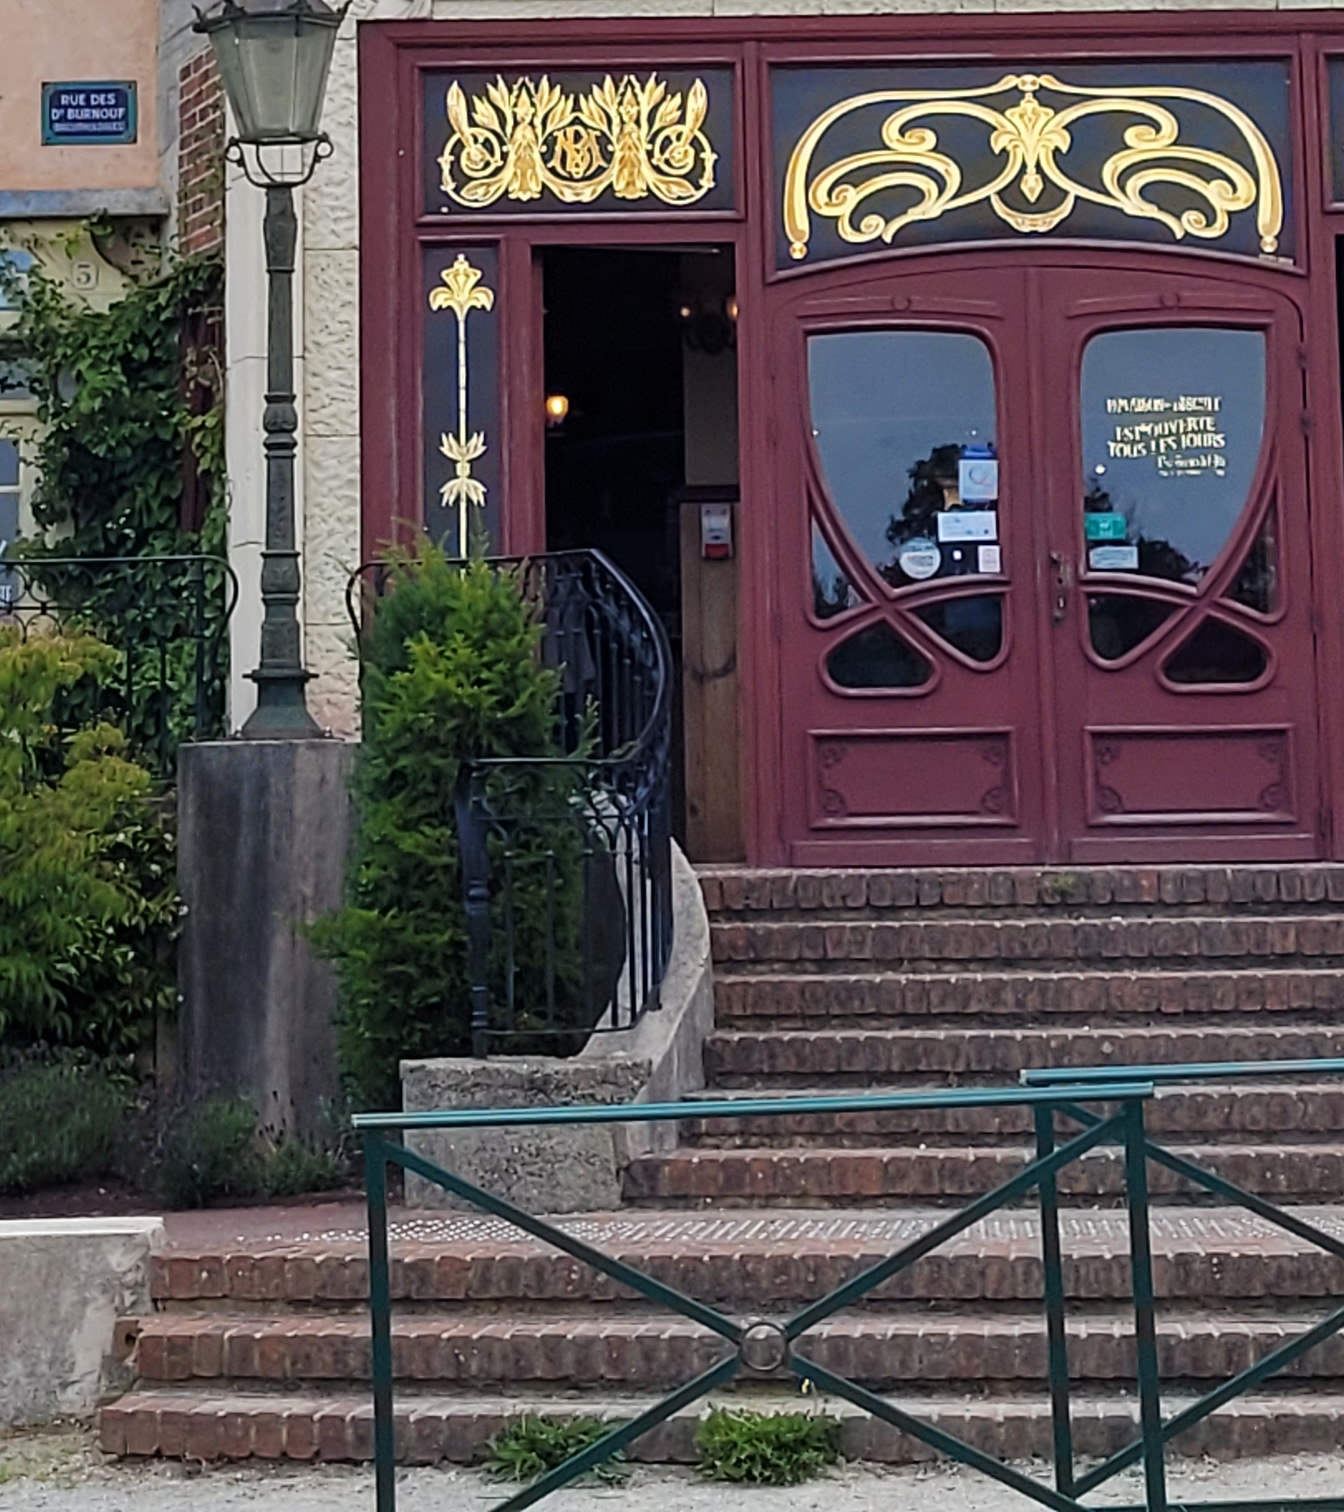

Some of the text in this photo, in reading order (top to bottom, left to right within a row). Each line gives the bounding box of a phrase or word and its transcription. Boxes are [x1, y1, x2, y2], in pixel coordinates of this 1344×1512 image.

[60, 92, 116, 106] RUE DES
[67, 107, 125, 120] BURNOUF
